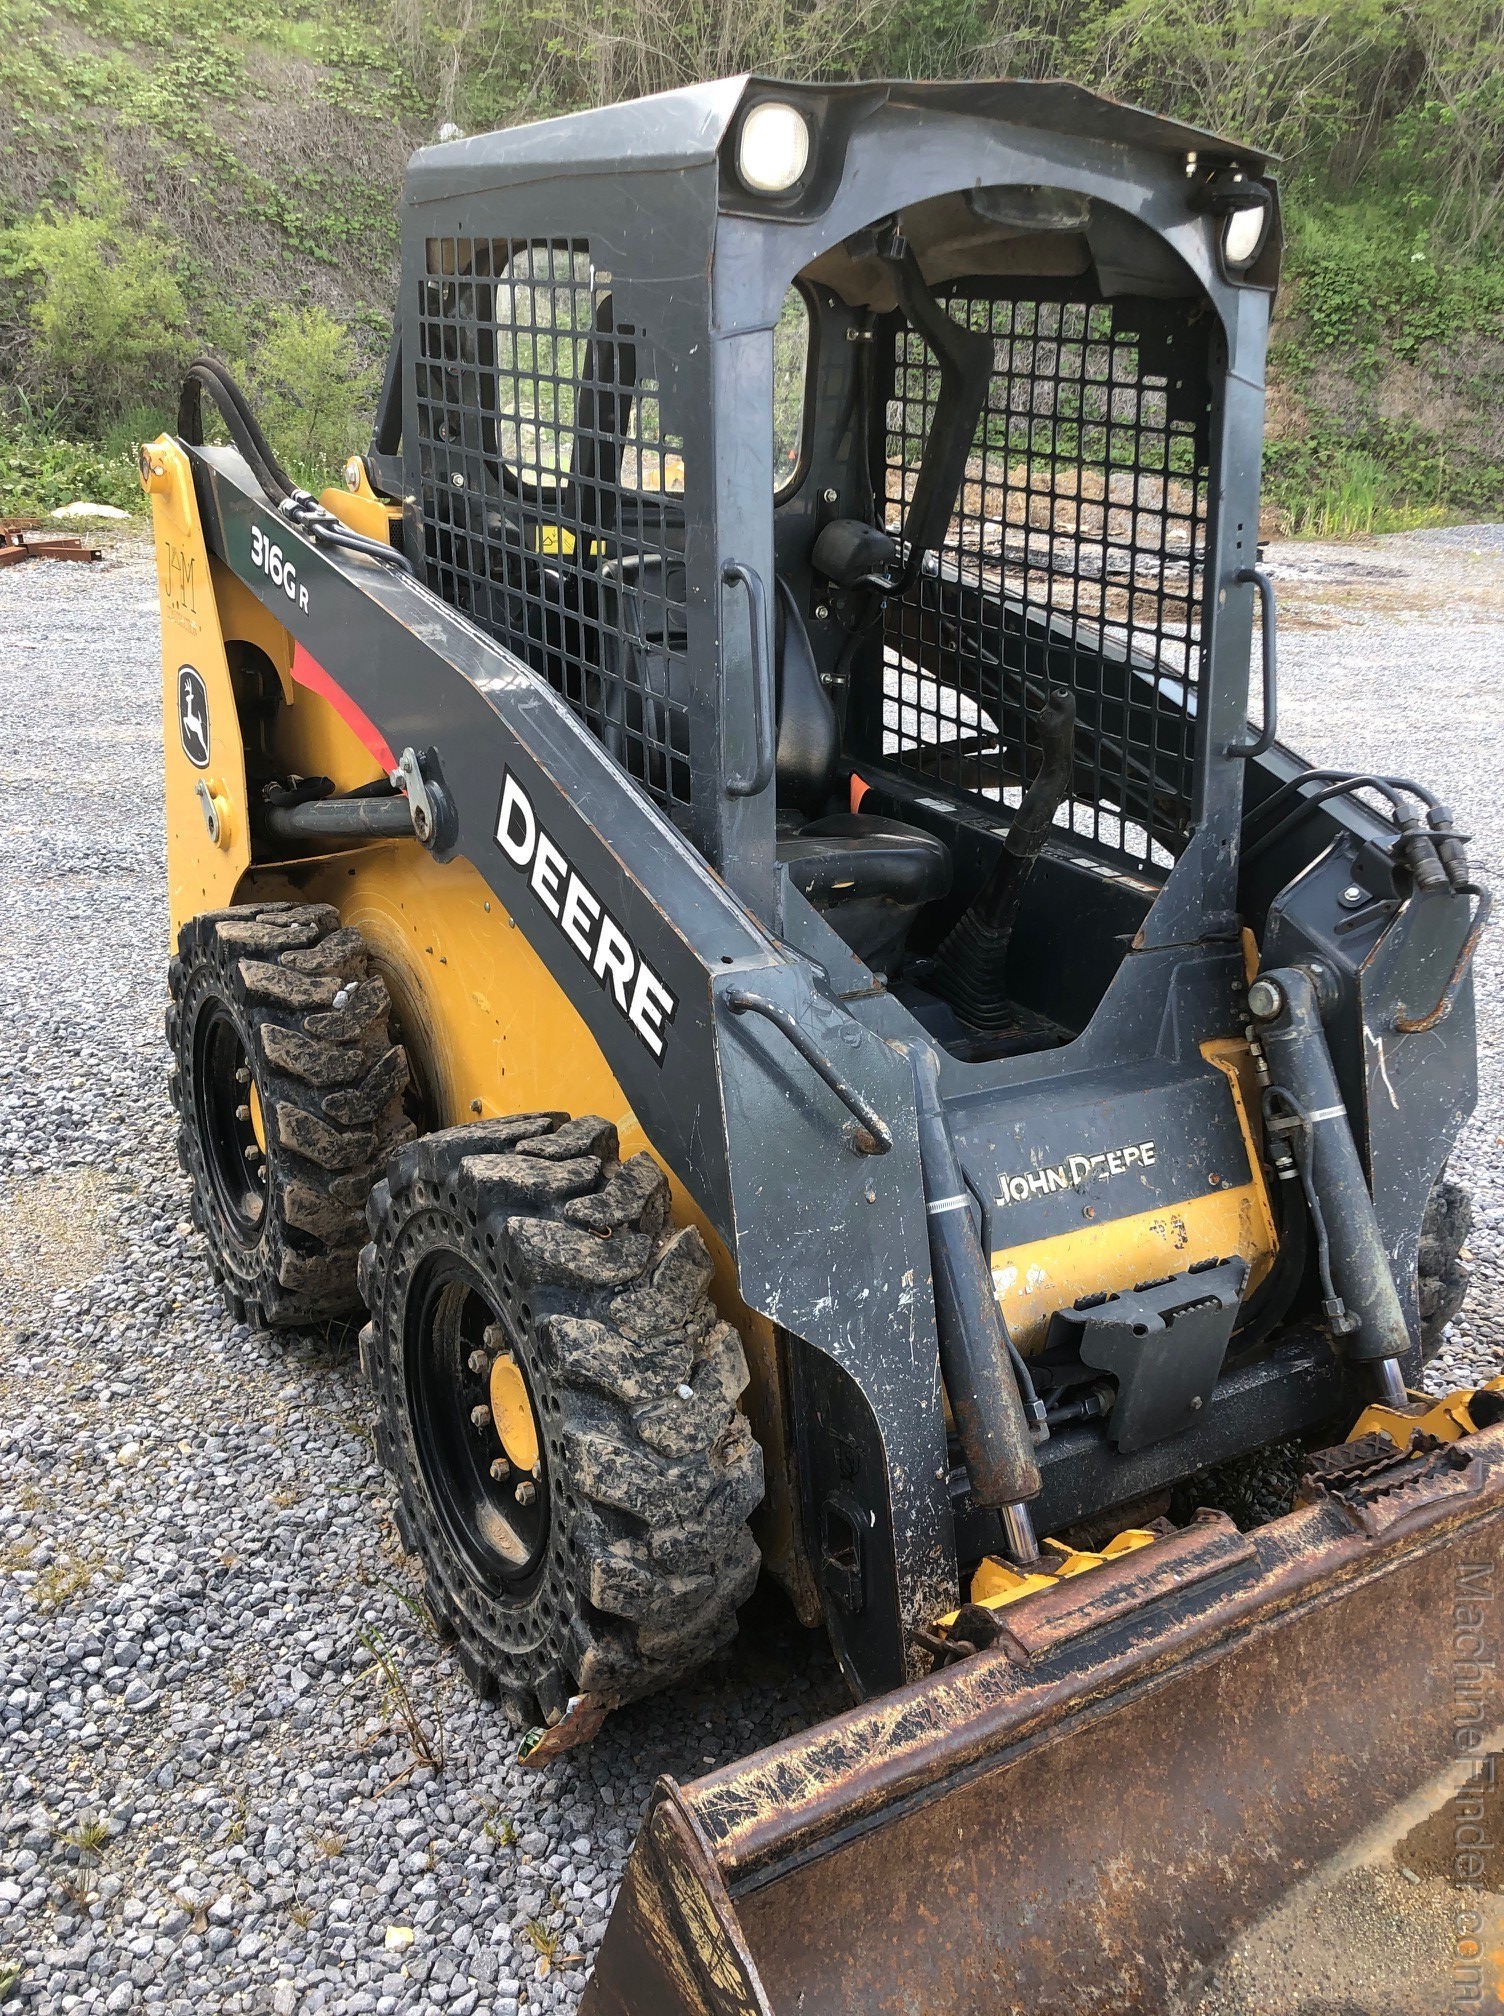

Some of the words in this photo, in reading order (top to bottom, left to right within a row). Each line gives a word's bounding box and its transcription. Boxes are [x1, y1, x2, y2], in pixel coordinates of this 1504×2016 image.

[251, 525, 297, 600] 316G
[299, 583, 310, 615] R
[496, 772, 675, 1057] DEERE
[994, 1164, 1068, 1207] JOHN
